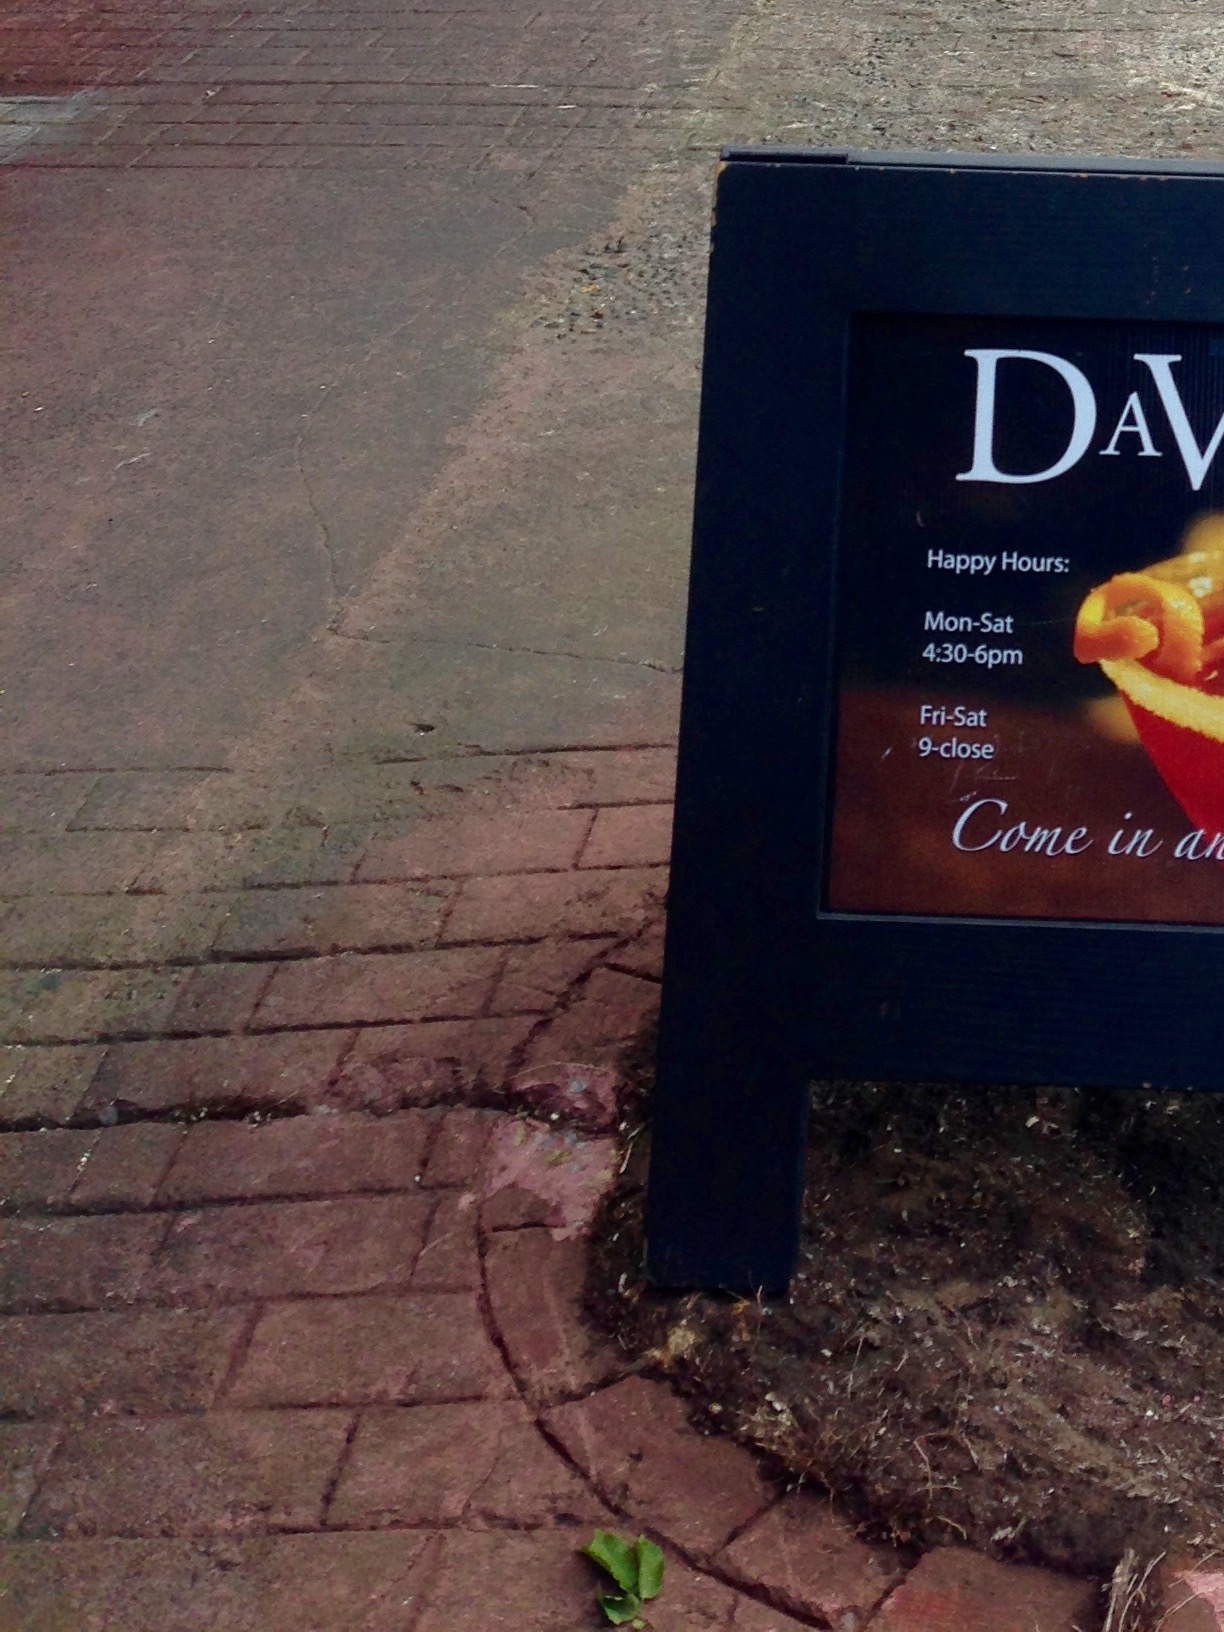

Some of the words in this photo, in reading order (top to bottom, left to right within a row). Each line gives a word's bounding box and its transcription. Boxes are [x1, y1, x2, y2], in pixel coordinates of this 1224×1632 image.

[926, 548, 997, 576] Happy
[1001, 551, 1070, 573] Hours:
[923, 610, 1014, 634] Mon-Sat
[922, 642, 1023, 669] 4:30-6pm
[919, 704, 988, 728] Fri-Sat
[917, 736, 995, 760] 9-close
[951, 797, 1093, 857] Come
[1107, 811, 1164, 859] in
